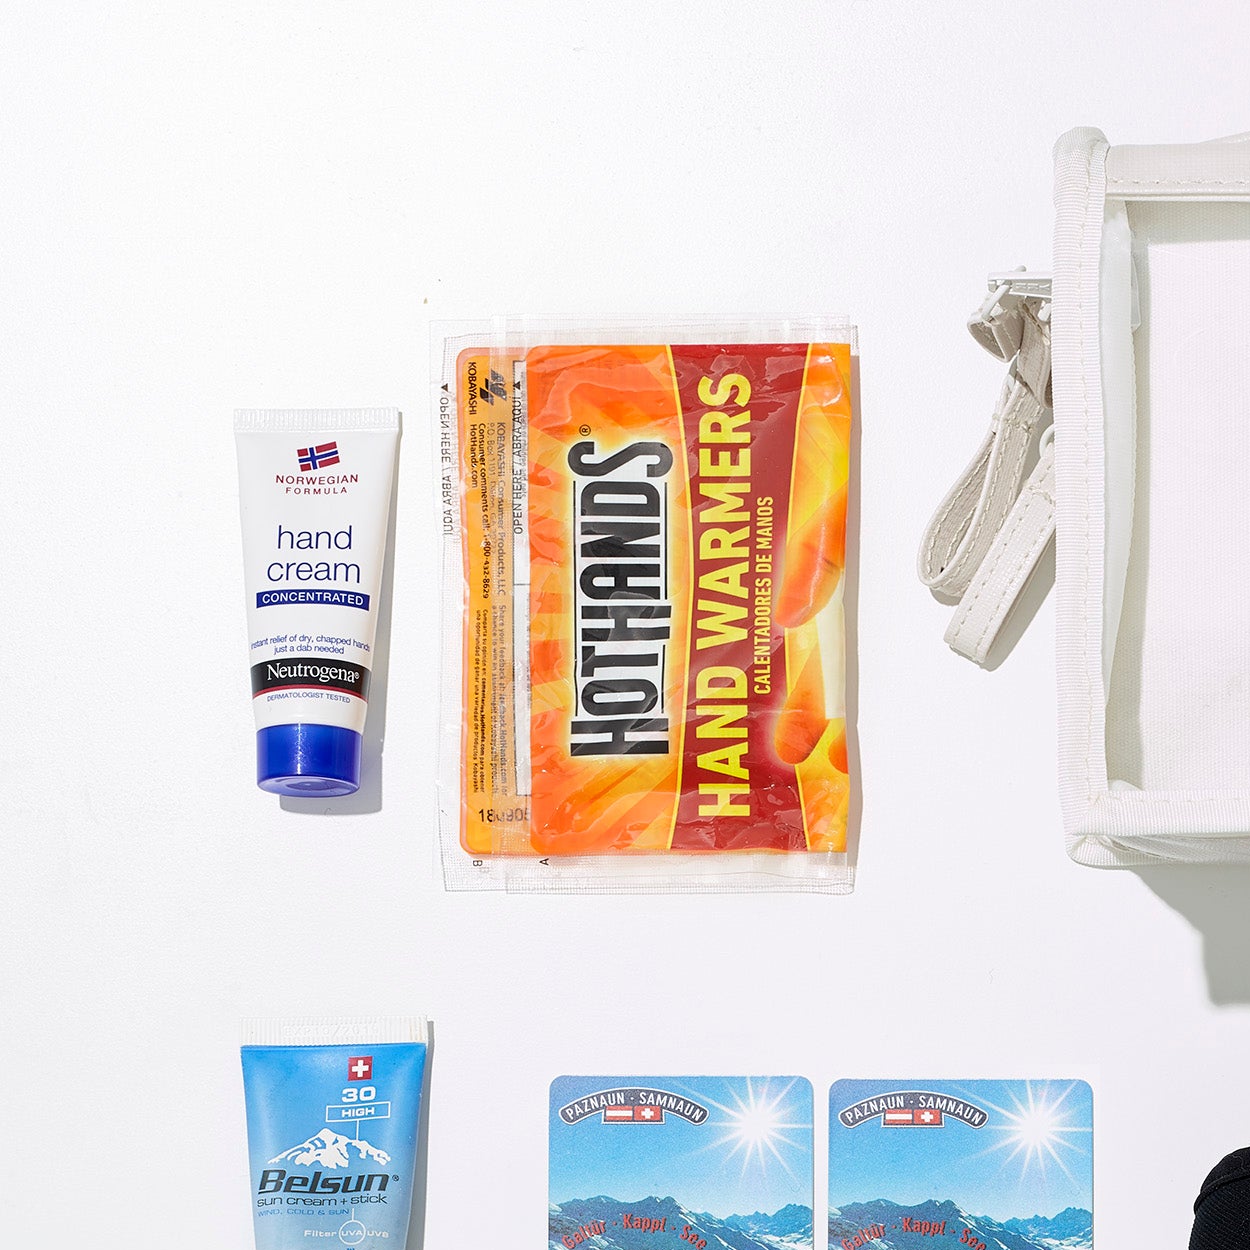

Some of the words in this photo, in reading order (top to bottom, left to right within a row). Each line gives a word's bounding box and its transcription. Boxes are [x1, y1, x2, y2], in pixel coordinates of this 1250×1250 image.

[468, 362, 477, 415] KOBAYASHI
[478, 423, 486, 466] Consumer
[470, 424, 479, 488] HotHands.com
[275, 474, 359, 485] NORWEGIAN
[480, 468, 489, 512] comments
[285, 487, 347, 495] FORMULA
[512, 503, 523, 535] OPEN
[696, 373, 751, 650] WARMERS
[756, 496, 773, 550] MANOS
[278, 525, 352, 550] hand
[267, 562, 360, 584] cream
[755, 553, 773, 573] DE
[262, 592, 364, 606] CONCENTRATED
[269, 635, 288, 644] relief
[289, 634, 297, 643] of
[298, 634, 314, 644] dry,
[316, 634, 351, 647] chapped
[753, 577, 772, 694] CALENTADORES
[273, 644, 288, 655] just
[296, 644, 312, 652] dab
[314, 645, 344, 655] needed
[267, 692, 324, 702] DERMATOLOGIST
[326, 693, 351, 703] TESTED
[695, 665, 751, 816] HAND
[341, 1086, 376, 1103] 30
[341, 1107, 375, 1117] HIGH
[565, 1092, 625, 1120] PAZNAUN
[639, 1091, 704, 1121] SAMNAUN
[844, 1095, 905, 1124] PAZNAUN
[918, 1094, 984, 1125] SAMNAUN
[257, 1197, 283, 1208] sun
[286, 1197, 337, 1207] cream
[350, 1193, 388, 1204] stick
[287, 1208, 314, 1216] COLD
[328, 1208, 350, 1216] SUN
[303, 1229, 337, 1238] Filter
[561, 1219, 606, 1249] Galtür
[622, 1213, 667, 1233] Kappl
[679, 1224, 708, 1250] See
[901, 1216, 947, 1237] Kappl
